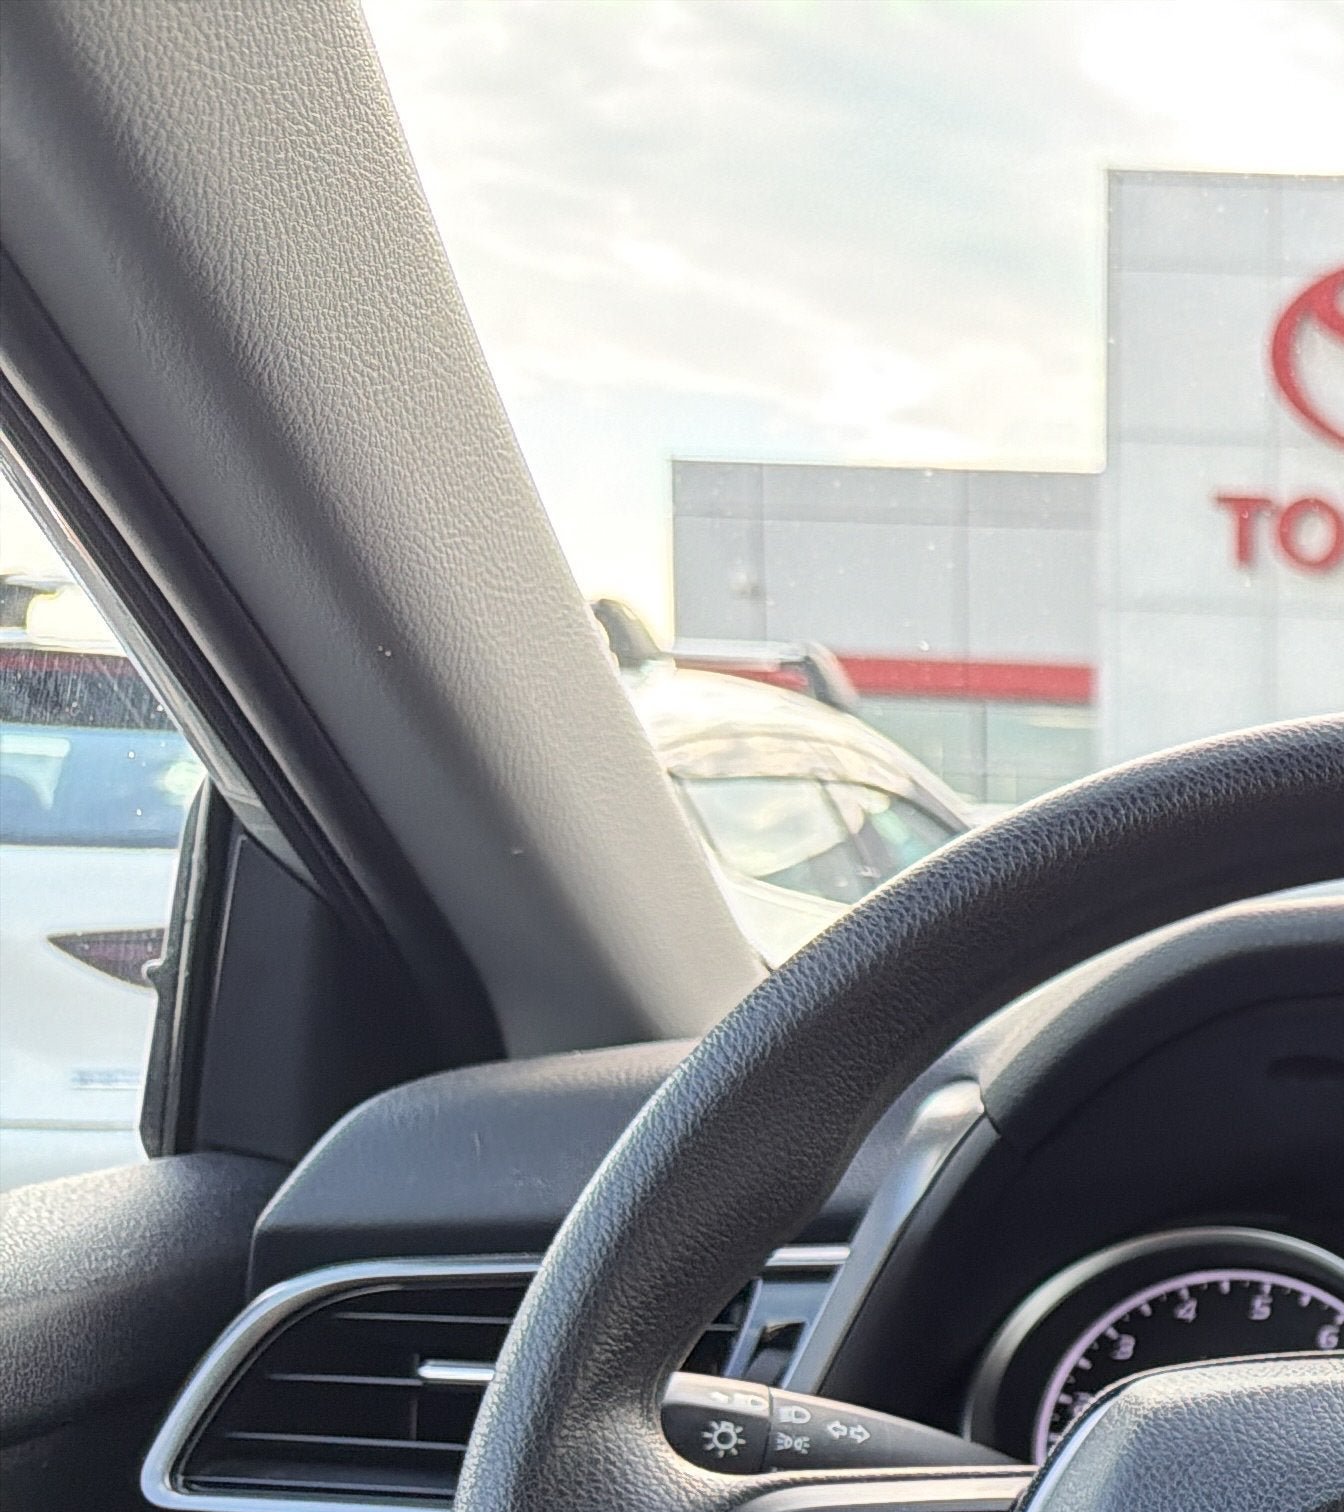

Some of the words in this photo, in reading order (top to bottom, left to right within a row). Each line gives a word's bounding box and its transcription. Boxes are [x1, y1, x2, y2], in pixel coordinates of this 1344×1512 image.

[1173, 1299, 1198, 1323] 4
[1251, 1294, 1272, 1321] 5
[1111, 1333, 1136, 1361] 3
[1316, 1324, 1340, 1350] 6
